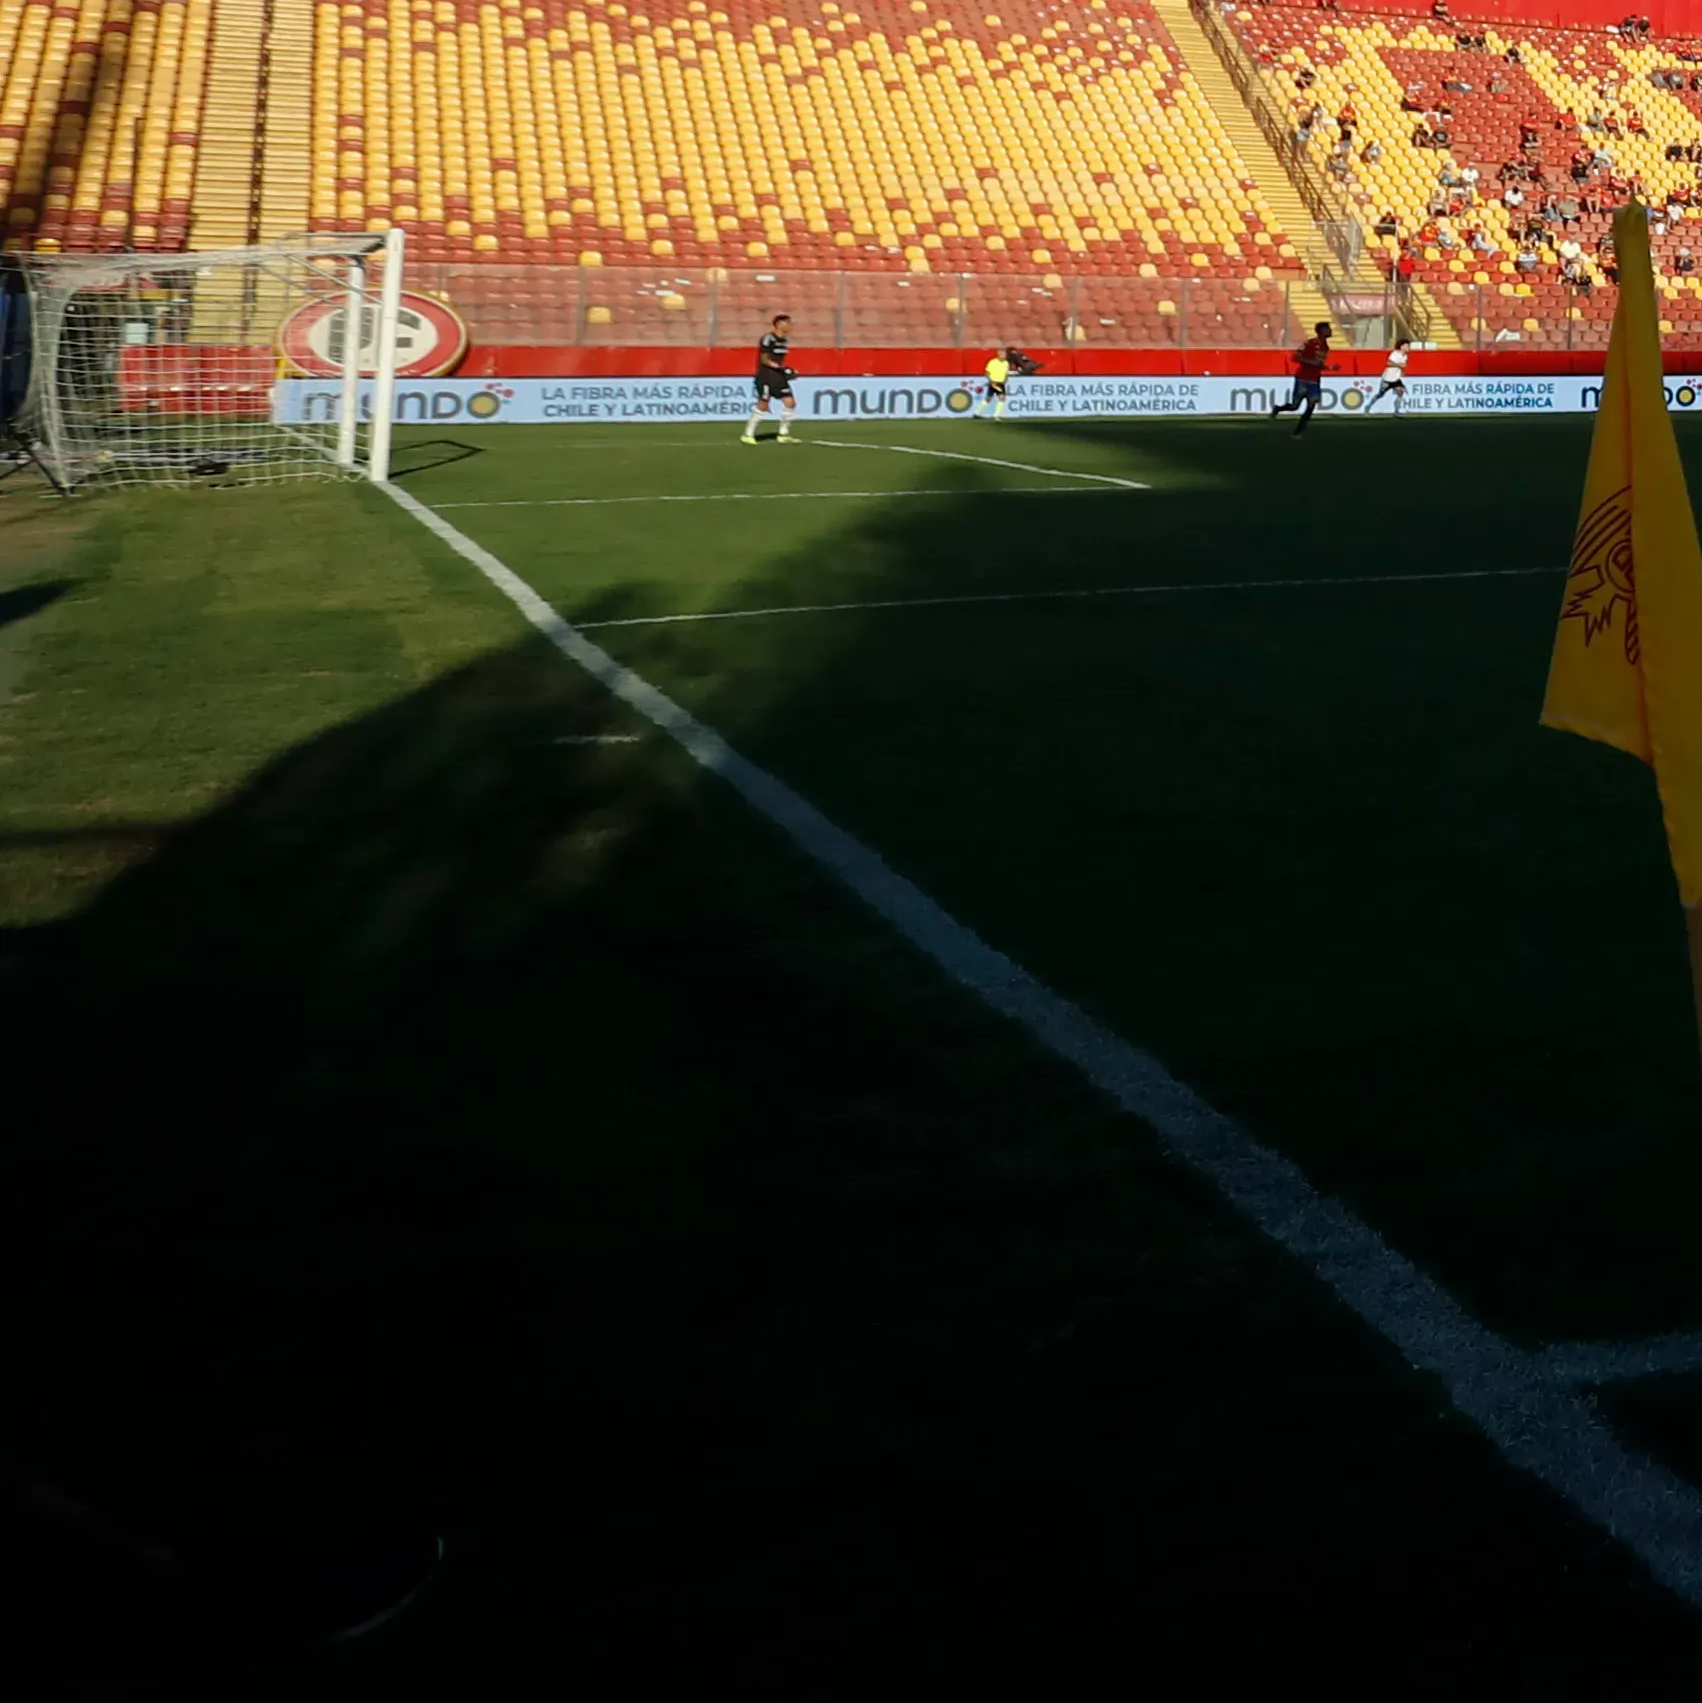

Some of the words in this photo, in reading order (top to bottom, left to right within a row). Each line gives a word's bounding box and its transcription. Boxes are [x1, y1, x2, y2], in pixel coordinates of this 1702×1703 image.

[542, 387, 565, 400] LA
[571, 386, 628, 400] FIBRA
[634, 382, 673, 400] MÁS
[679, 382, 747, 399] RÁPIDA
[1006, 385, 1026, 396] LA
[1030, 384, 1077, 397] FIBRA
[1082, 380, 1115, 396] MÁS
[1118, 380, 1174, 396] RÁPIDA
[1178, 384, 1199, 396] DE
[1412, 384, 1451, 395] FIBRA
[1455, 381, 1482, 395] MÁS
[1486, 381, 1534, 395] RÁPIDA
[1539, 383, 1555, 394] DE
[544, 403, 599, 417] CHILE
[605, 403, 617, 416] Y
[622, 400, 772, 417] LATINOAMÉRIC
[1008, 399, 1055, 412] CHILE
[1058, 400, 1070, 412] Y
[1072, 396, 1196, 412] LATINOAMÉRICA
[1402, 399, 1433, 409] HILE
[1435, 399, 1445, 408] Y
[1448, 396, 1552, 409] LATINOAMÉRICA
